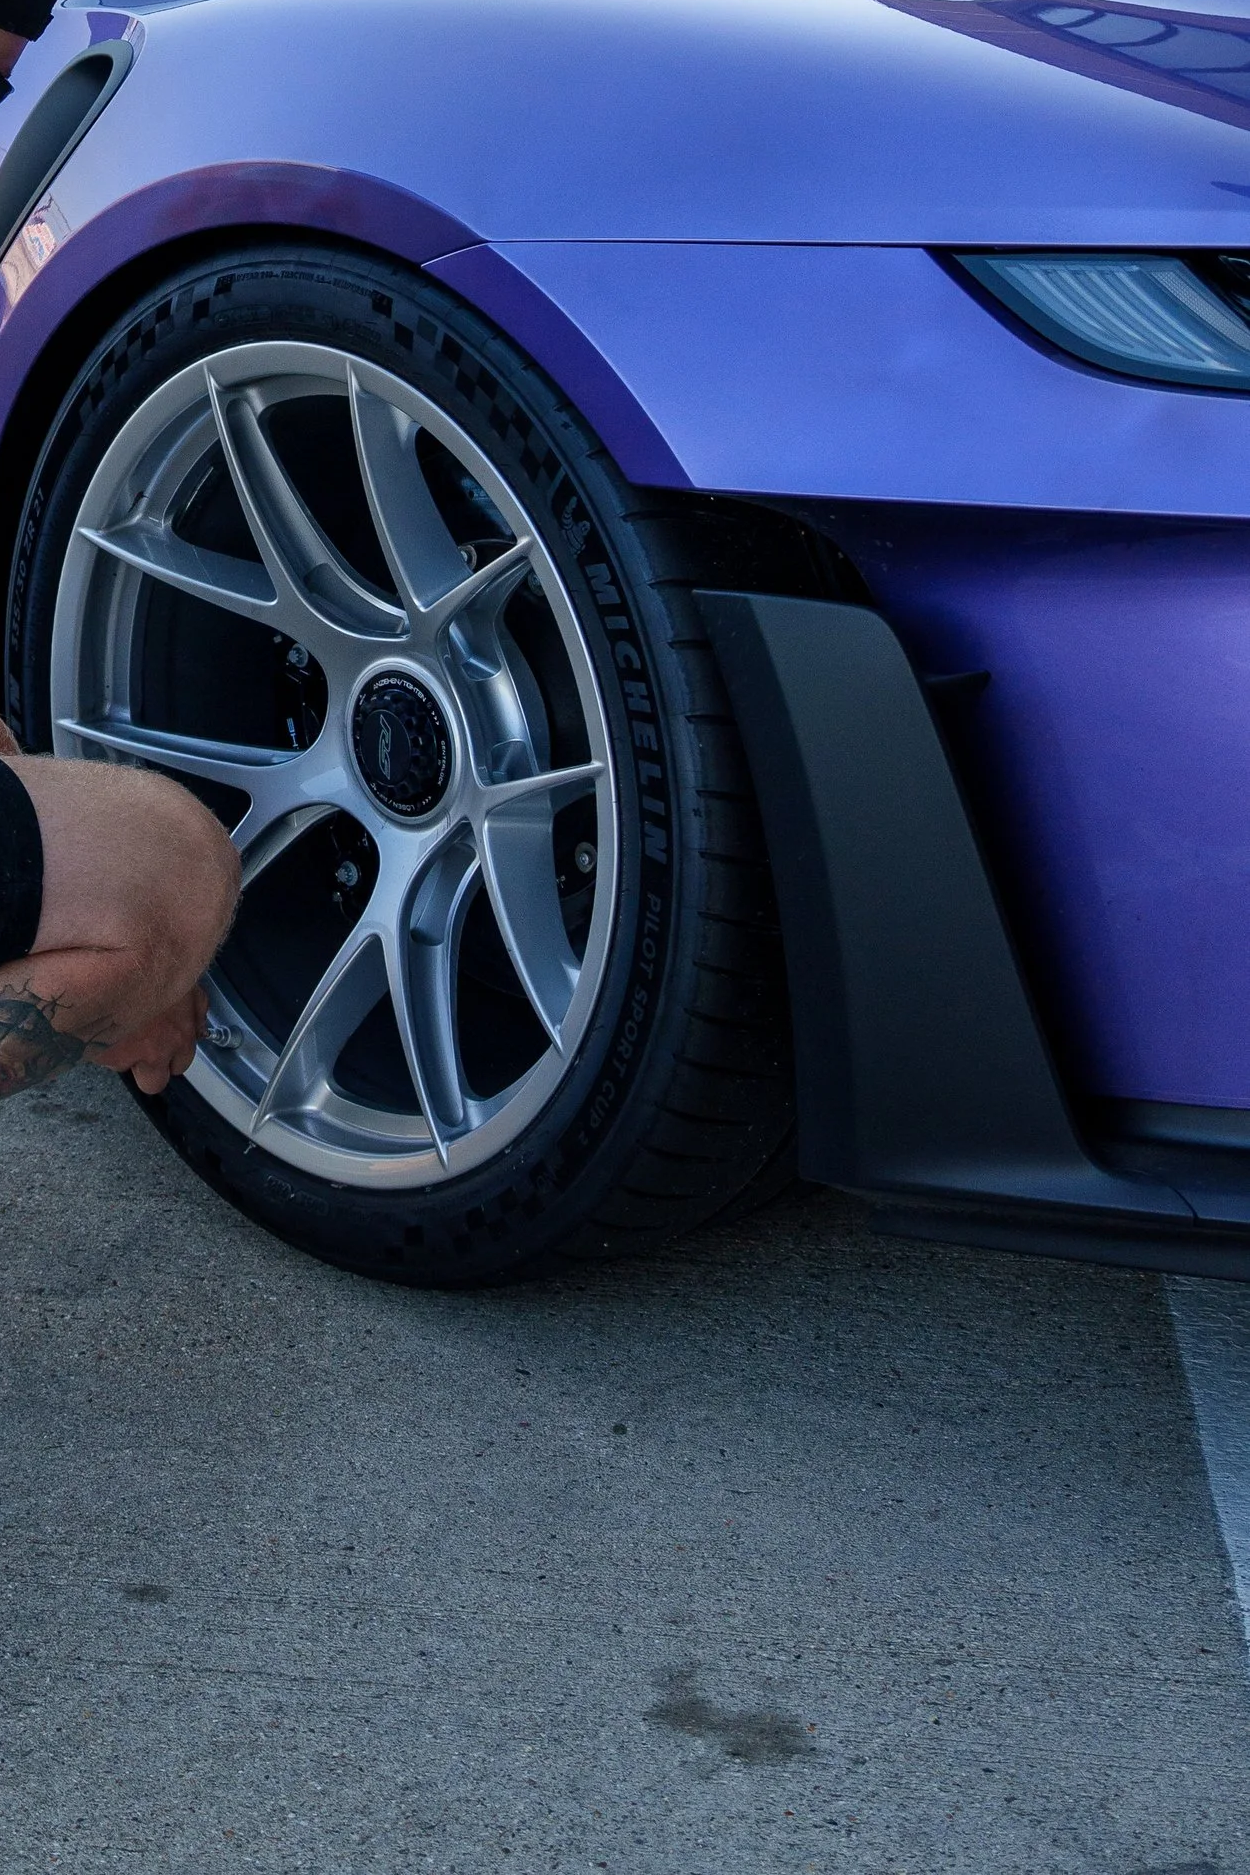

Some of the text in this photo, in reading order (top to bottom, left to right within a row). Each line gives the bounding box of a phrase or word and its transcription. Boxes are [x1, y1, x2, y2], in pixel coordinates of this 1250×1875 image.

[24, 522, 37, 557] ZR
[33, 486, 46, 518] 21
[584, 561, 669, 867] MICHELIN
[639, 889, 663, 982] PILOT
[612, 982, 649, 1080] SPORT
[589, 1079, 617, 1130] CUP
